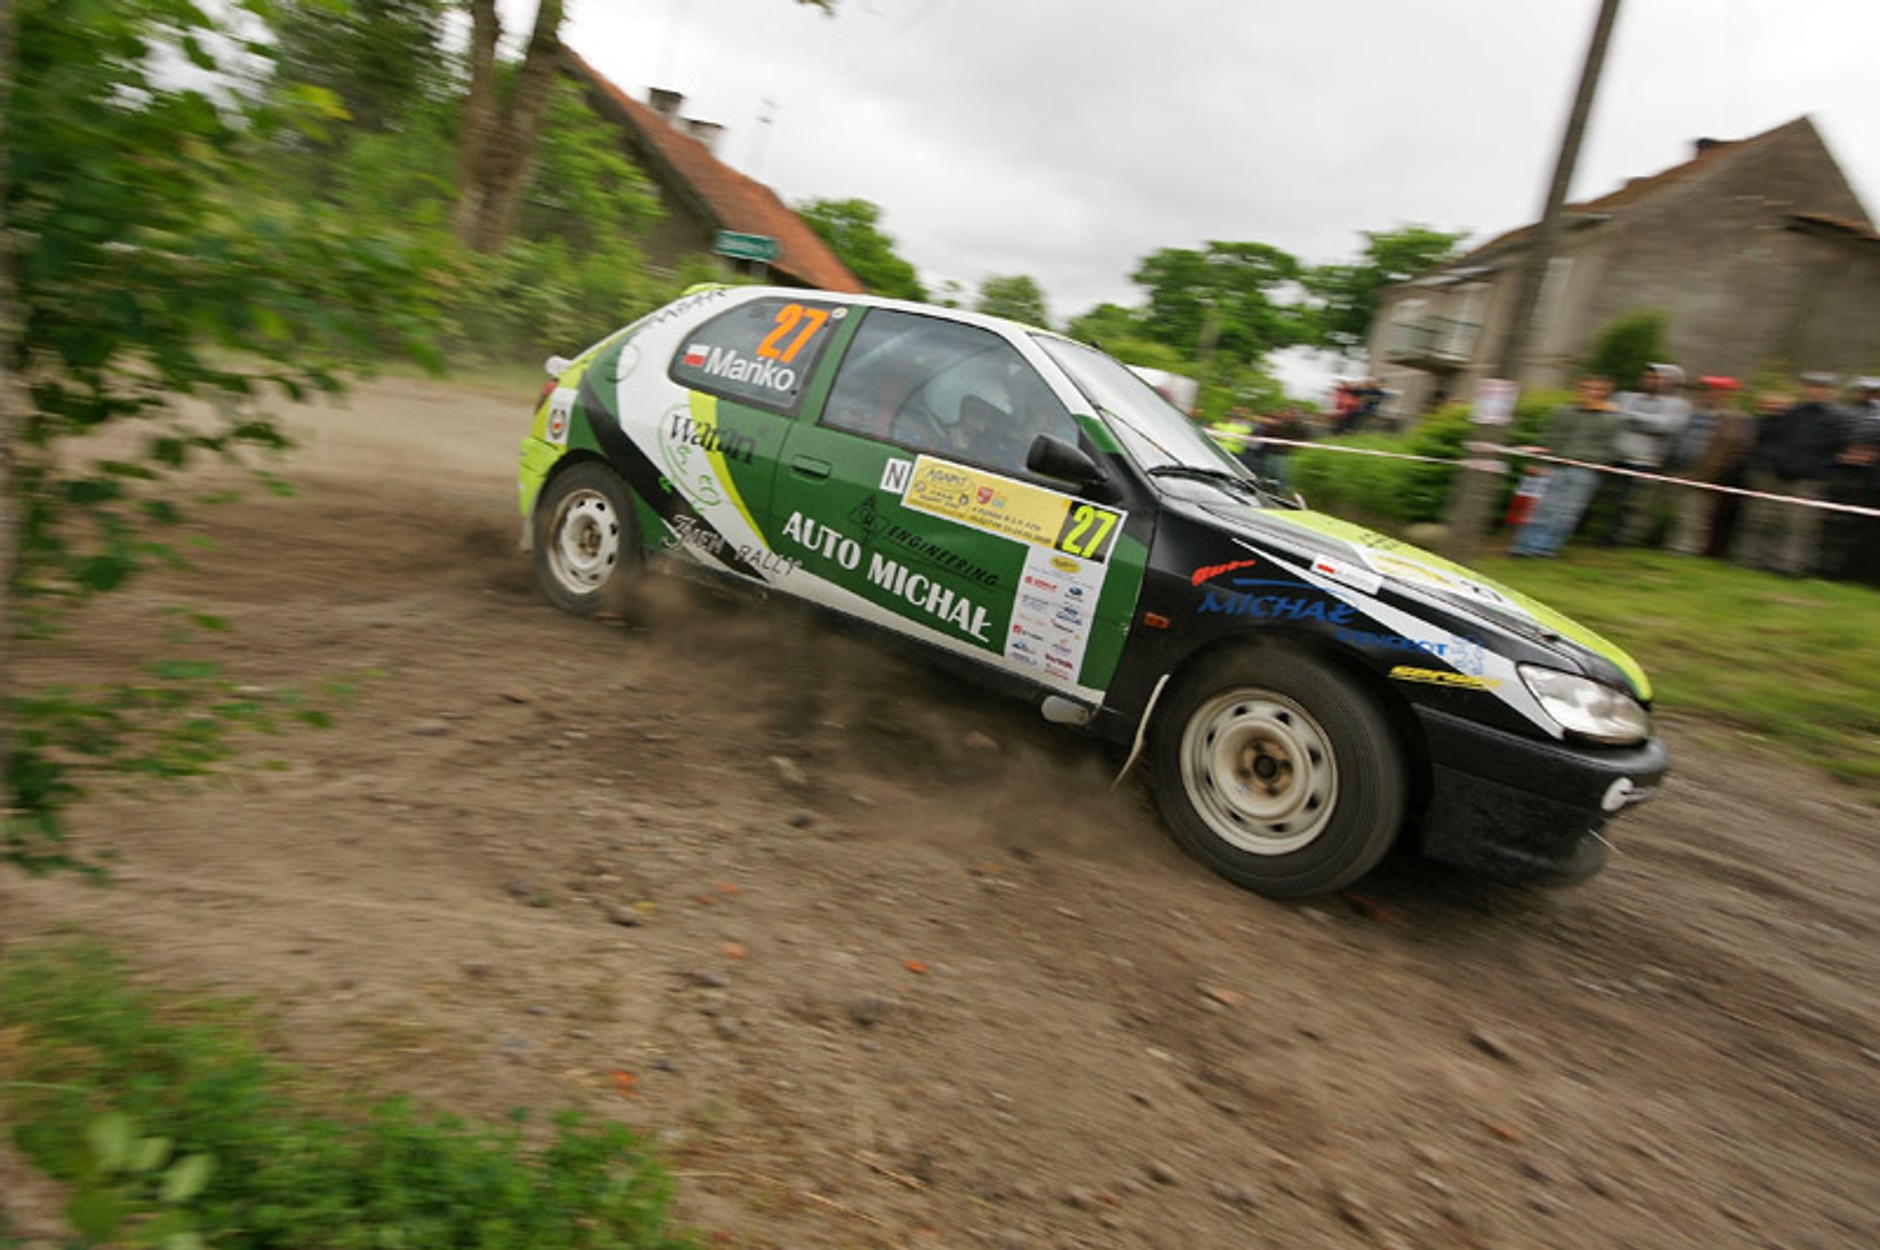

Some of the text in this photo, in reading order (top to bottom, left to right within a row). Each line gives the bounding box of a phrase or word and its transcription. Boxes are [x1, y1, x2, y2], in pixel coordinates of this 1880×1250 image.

[756, 303, 831, 364] 27
[704, 346, 796, 392] Mańko
[884, 461, 907, 490] N
[888, 525, 999, 586] ENGINEERING
[1062, 504, 1118, 559] 27
[781, 510, 993, 644] AUTO MICHAŁ
[1196, 589, 1362, 625] MICHAŁ
